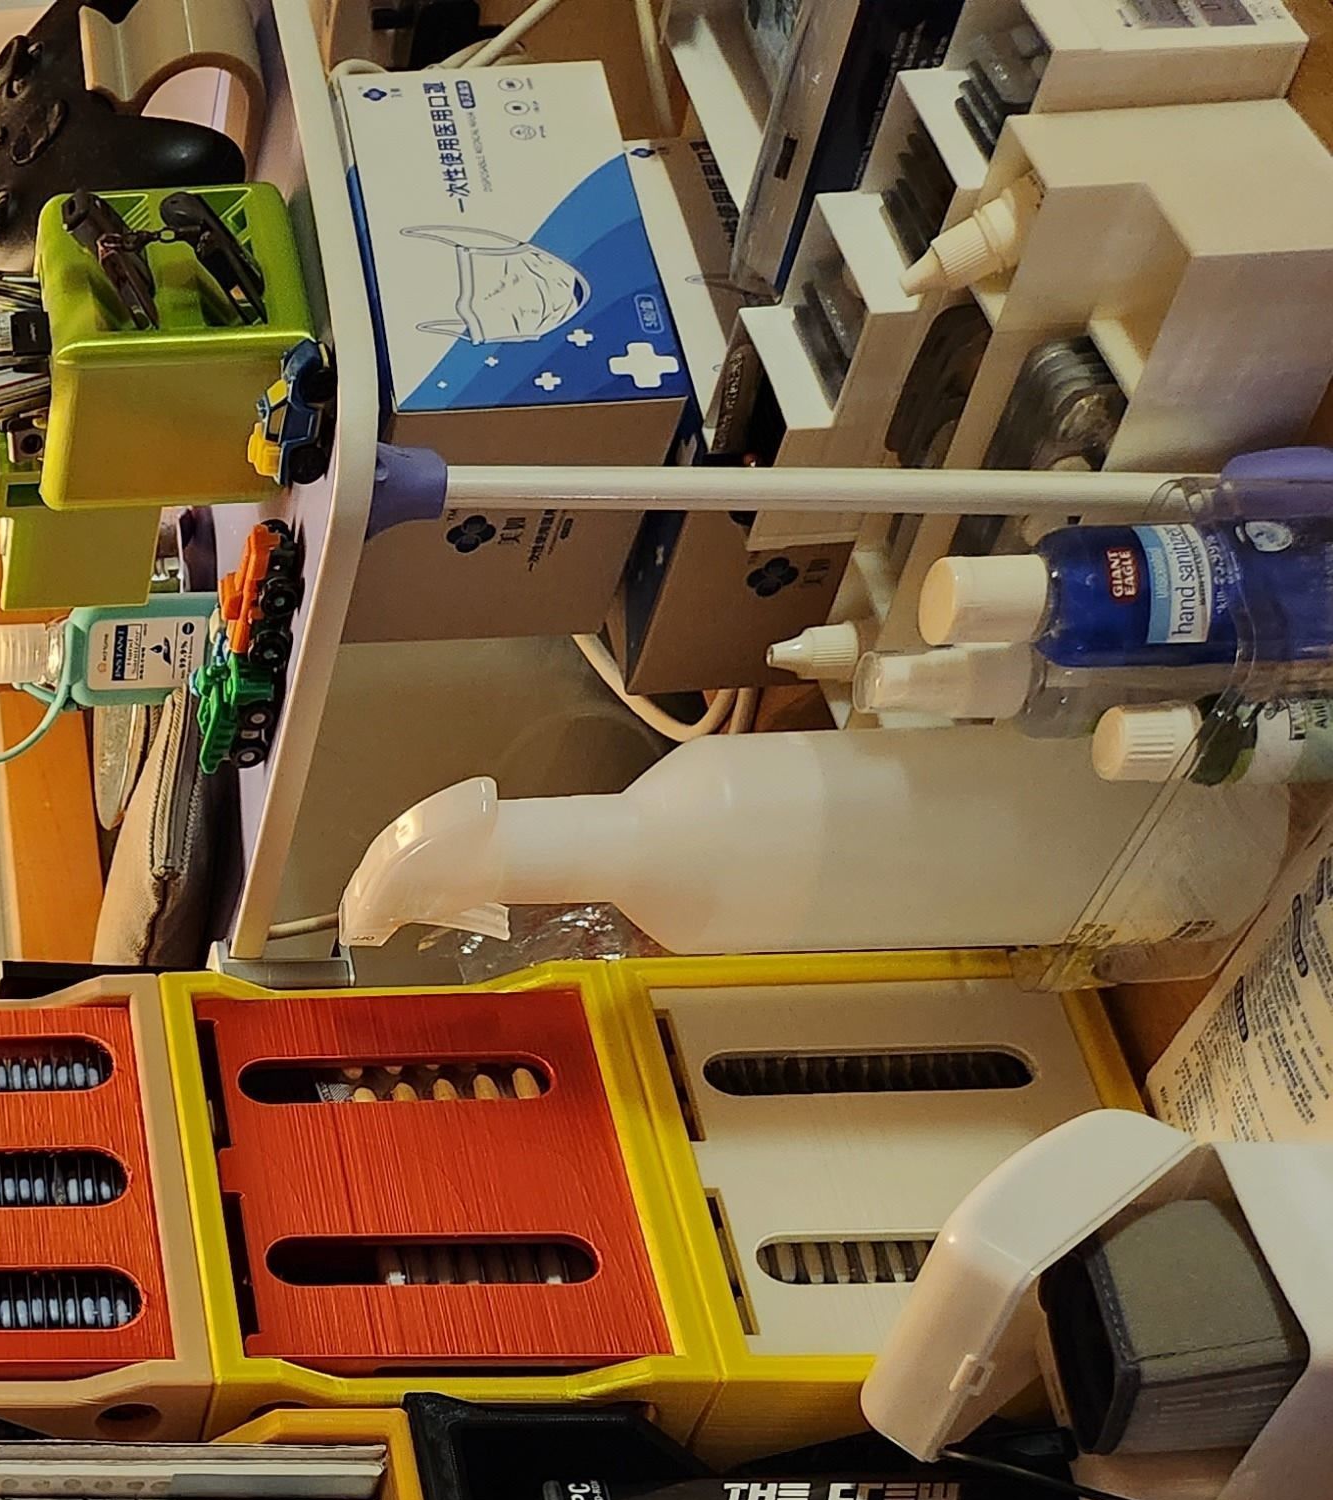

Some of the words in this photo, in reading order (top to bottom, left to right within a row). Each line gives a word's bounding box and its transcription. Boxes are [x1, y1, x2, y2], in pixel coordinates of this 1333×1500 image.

[423, 81, 471, 213] 一次性使用医用口罩
[1106, 550, 1124, 598] GIANT
[1118, 550, 1137, 596] EAGLE
[1162, 525, 1195, 582] sanitizer
[1171, 586, 1196, 635] hand
[114, 629, 126, 678] INSTANT
